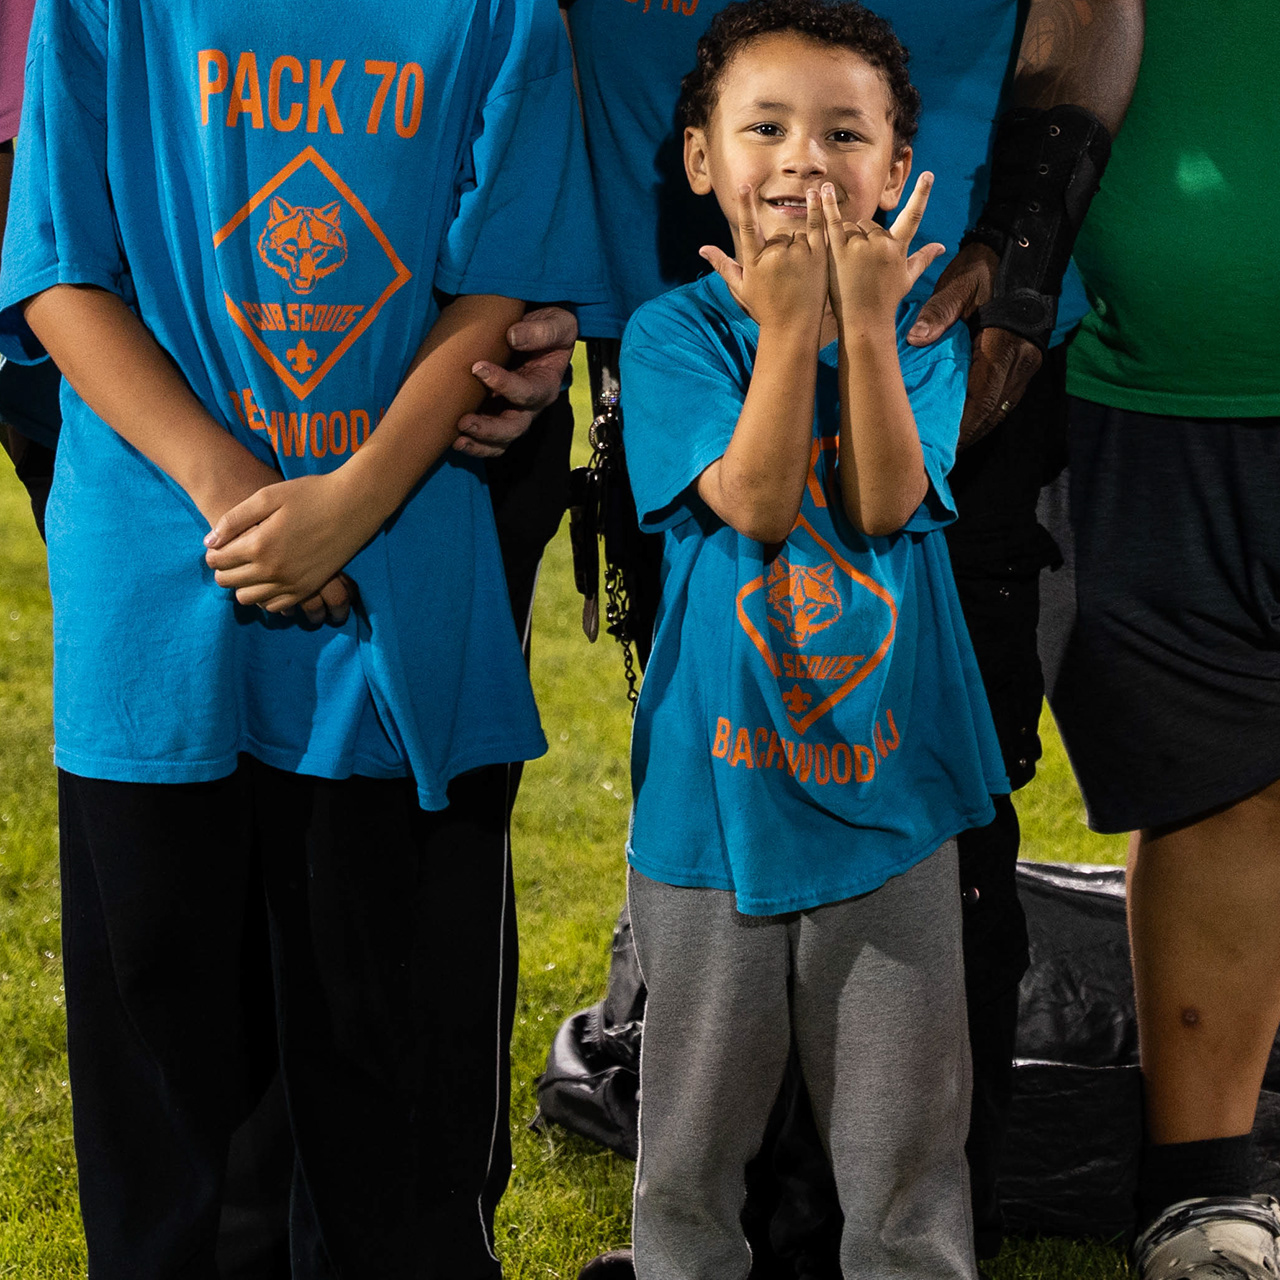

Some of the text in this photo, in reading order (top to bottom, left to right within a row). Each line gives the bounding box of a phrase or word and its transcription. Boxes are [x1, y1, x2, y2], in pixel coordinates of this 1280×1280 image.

[197, 48, 426, 139] PACK 70
[286, 302, 366, 332] SCOUTS
[782, 652, 866, 680] SCOUTS
[711, 716, 876, 786] BACHWOOD
